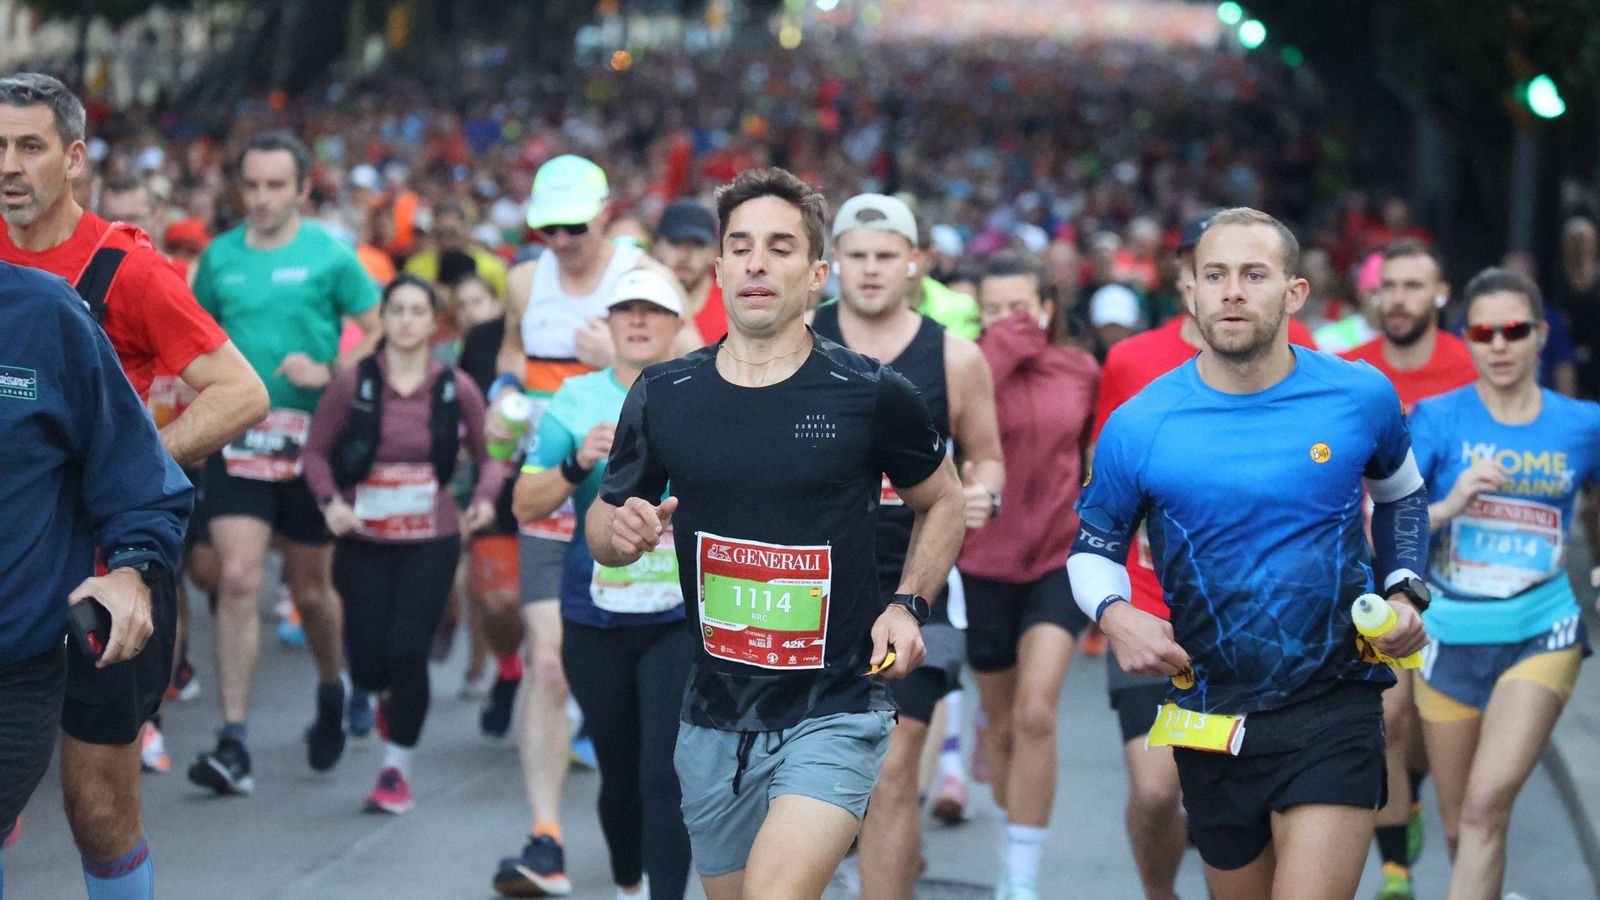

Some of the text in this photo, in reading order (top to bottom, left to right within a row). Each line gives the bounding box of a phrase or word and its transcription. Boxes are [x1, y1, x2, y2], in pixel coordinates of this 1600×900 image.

[1079, 528, 1121, 552] TGC
[1475, 532, 1537, 557] 17814
[733, 547, 821, 571] GENERALI
[733, 585, 792, 614] 1114
[751, 612, 768, 623] RRC
[782, 639, 807, 649] 42K
[1165, 709, 1208, 730] 1113
